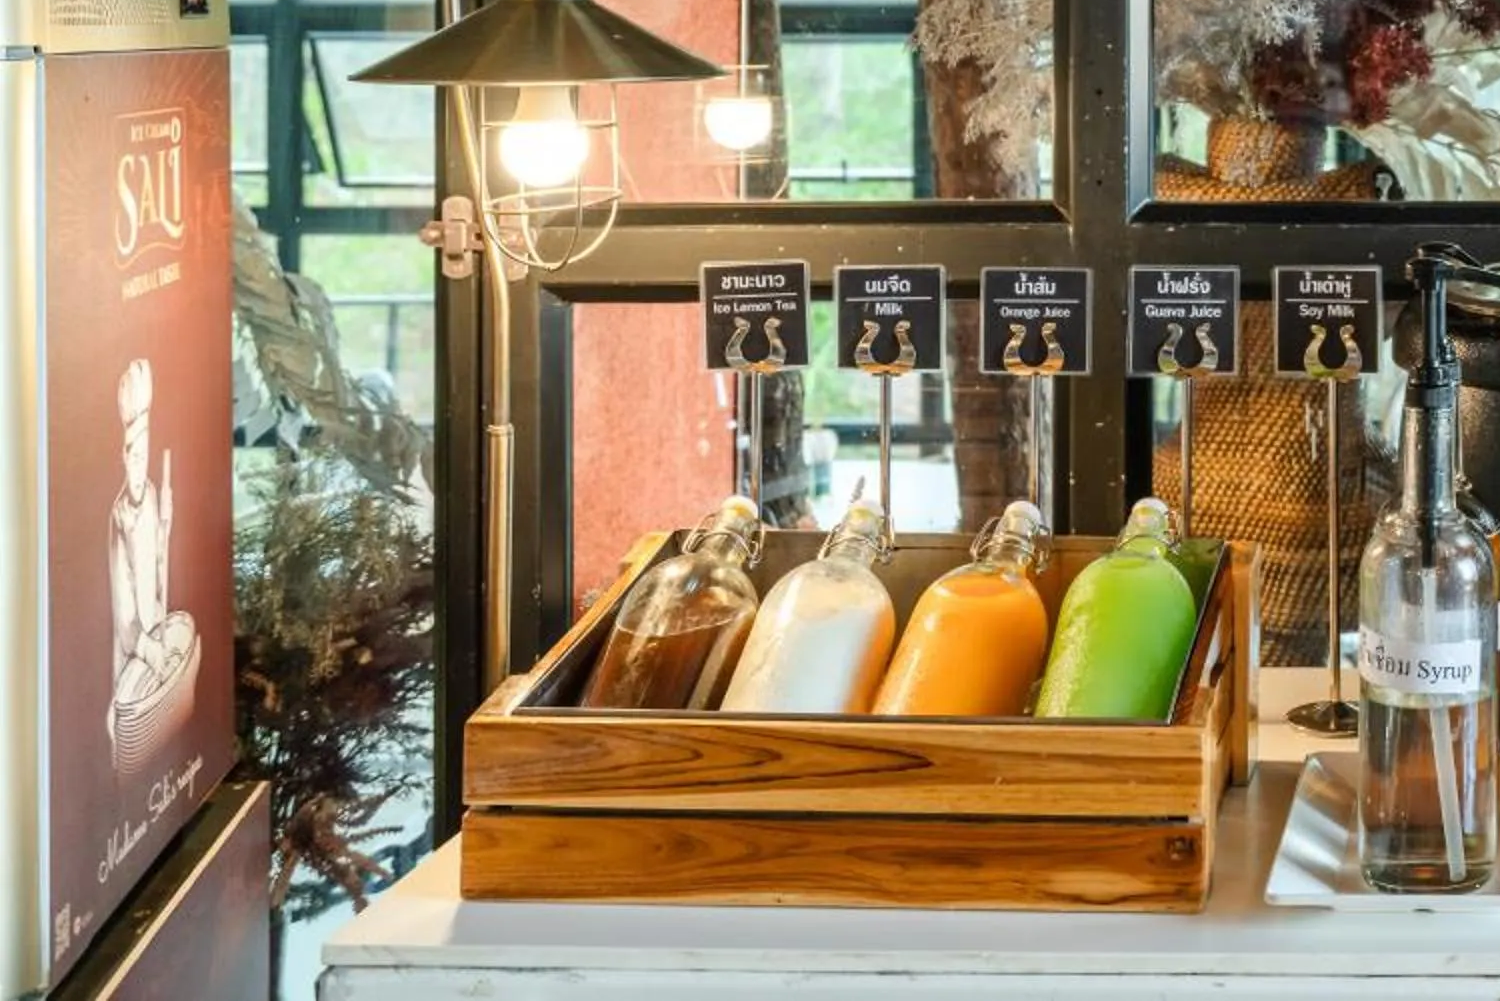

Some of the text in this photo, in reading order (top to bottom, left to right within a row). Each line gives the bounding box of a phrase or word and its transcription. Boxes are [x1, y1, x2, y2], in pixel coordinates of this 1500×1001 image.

[721, 274, 785, 289] ชามะนาว
[864, 274, 910, 293] นมจืด
[1014, 273, 1056, 295] น้ำส้ม
[1157, 272, 1211, 293] น้ำฝรั่ง
[1299, 271, 1352, 298] น้ำเต้าหู้
[713, 300, 797, 314] Ice Lemon Tea
[875, 302, 903, 315] Milk
[1000, 306, 1071, 319] Orange Juice
[1145, 304, 1222, 318] Guava Juice
[1299, 304, 1355, 319] Soy Milk
[1417, 659, 1473, 684] Syrup
